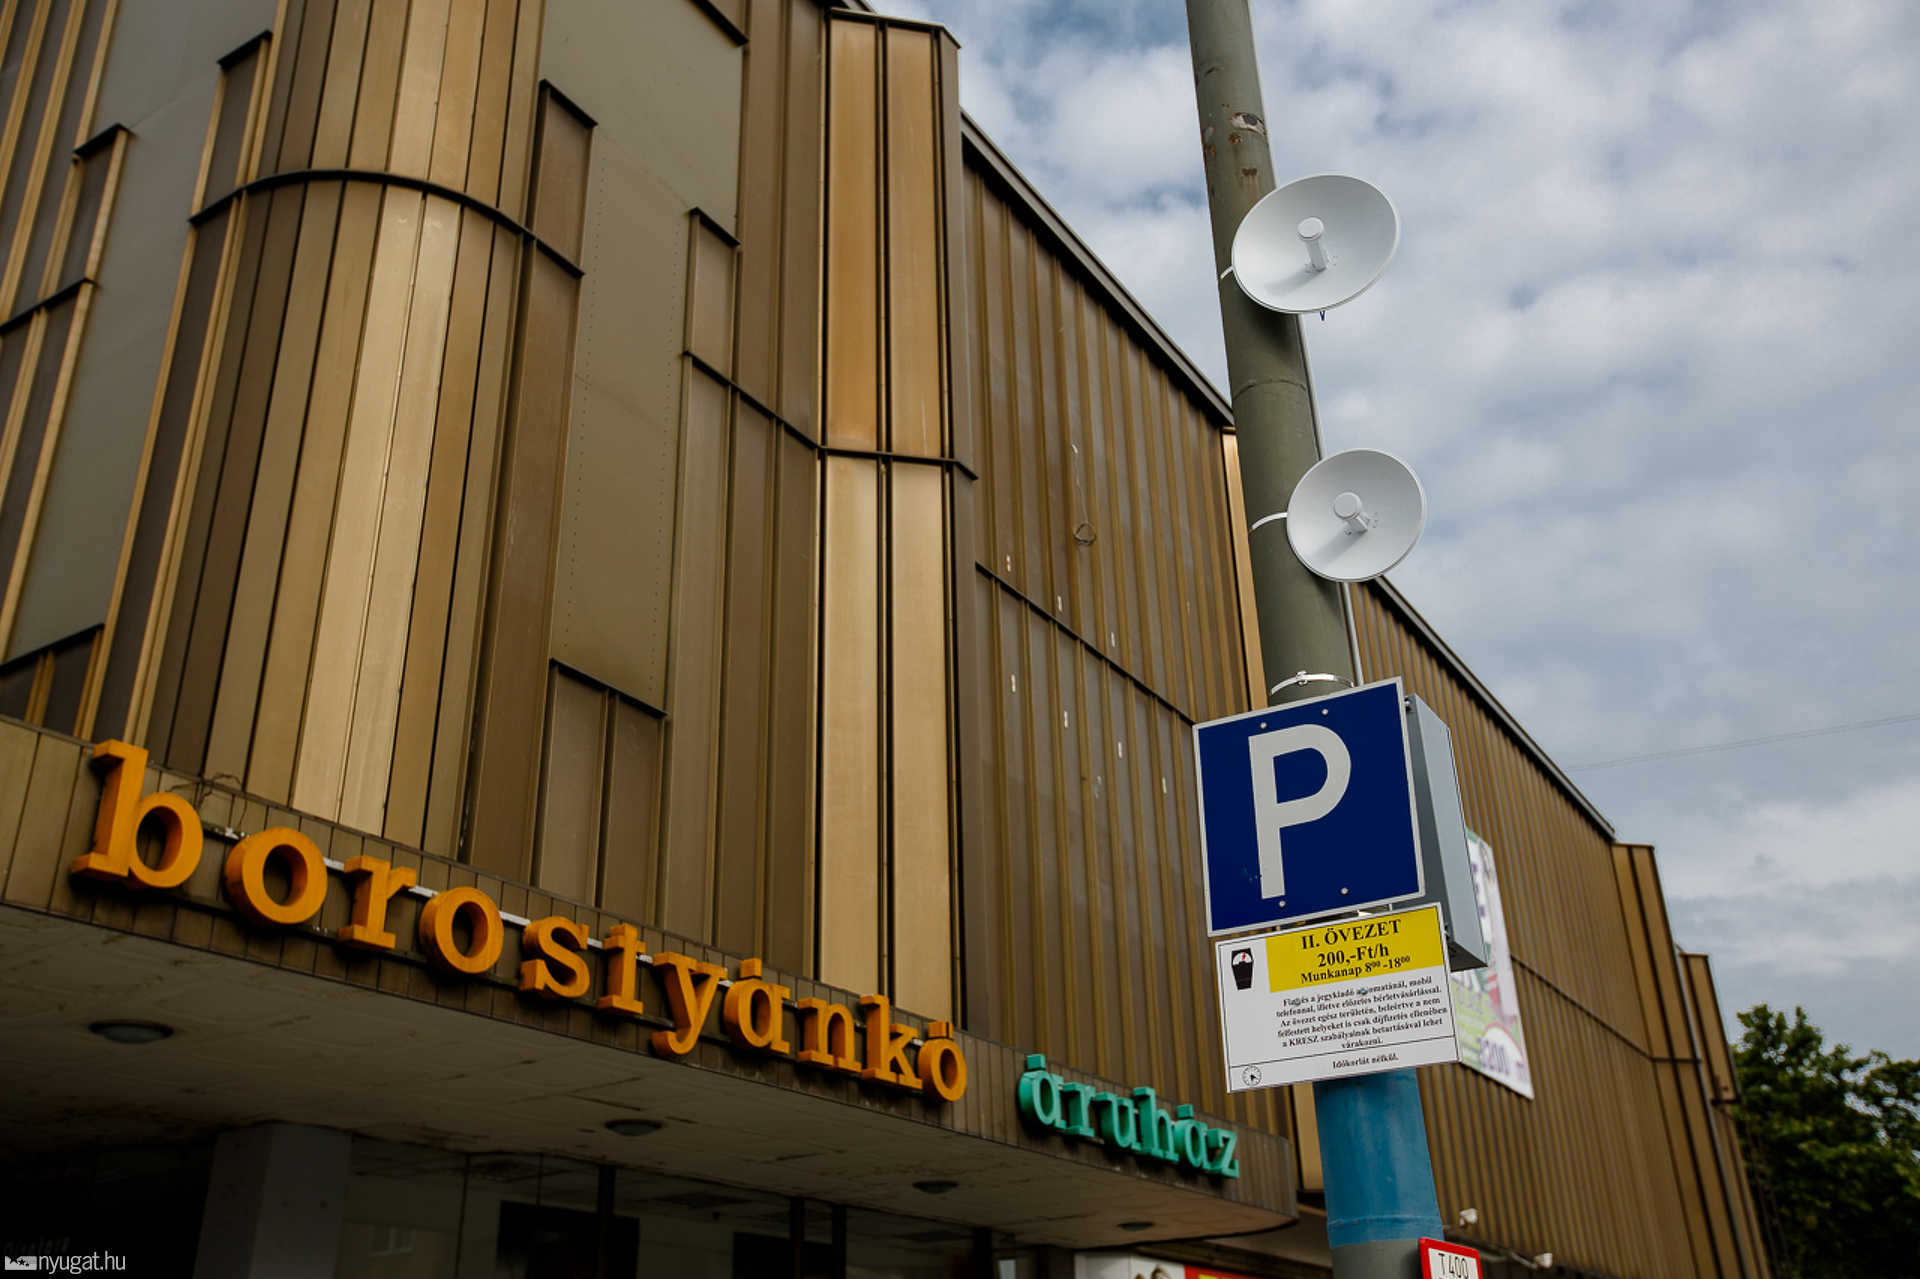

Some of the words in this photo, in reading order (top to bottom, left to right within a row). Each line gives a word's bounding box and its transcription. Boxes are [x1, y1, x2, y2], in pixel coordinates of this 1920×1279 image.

[1248, 724, 1351, 899] P
[70, 739, 968, 1102] borostyánkő
[1302, 935, 1320, 949] II.
[1324, 919, 1401, 945] ÖVEZET
[1318, 943, 1389, 967] 200,-Ft/h
[1301, 967, 1362, 984] Munkanap
[1409, 976, 1432, 987] mobil
[1423, 998, 1440, 1006] nem
[1312, 1022, 1343, 1033] helyeket
[1345, 1020, 1352, 1028] is
[1354, 1018, 1370, 1027] csak
[1372, 1021, 1421, 1034] betartásával
[1423, 1018, 1442, 1027] lehet
[1018, 1053, 1240, 1178] áruház
